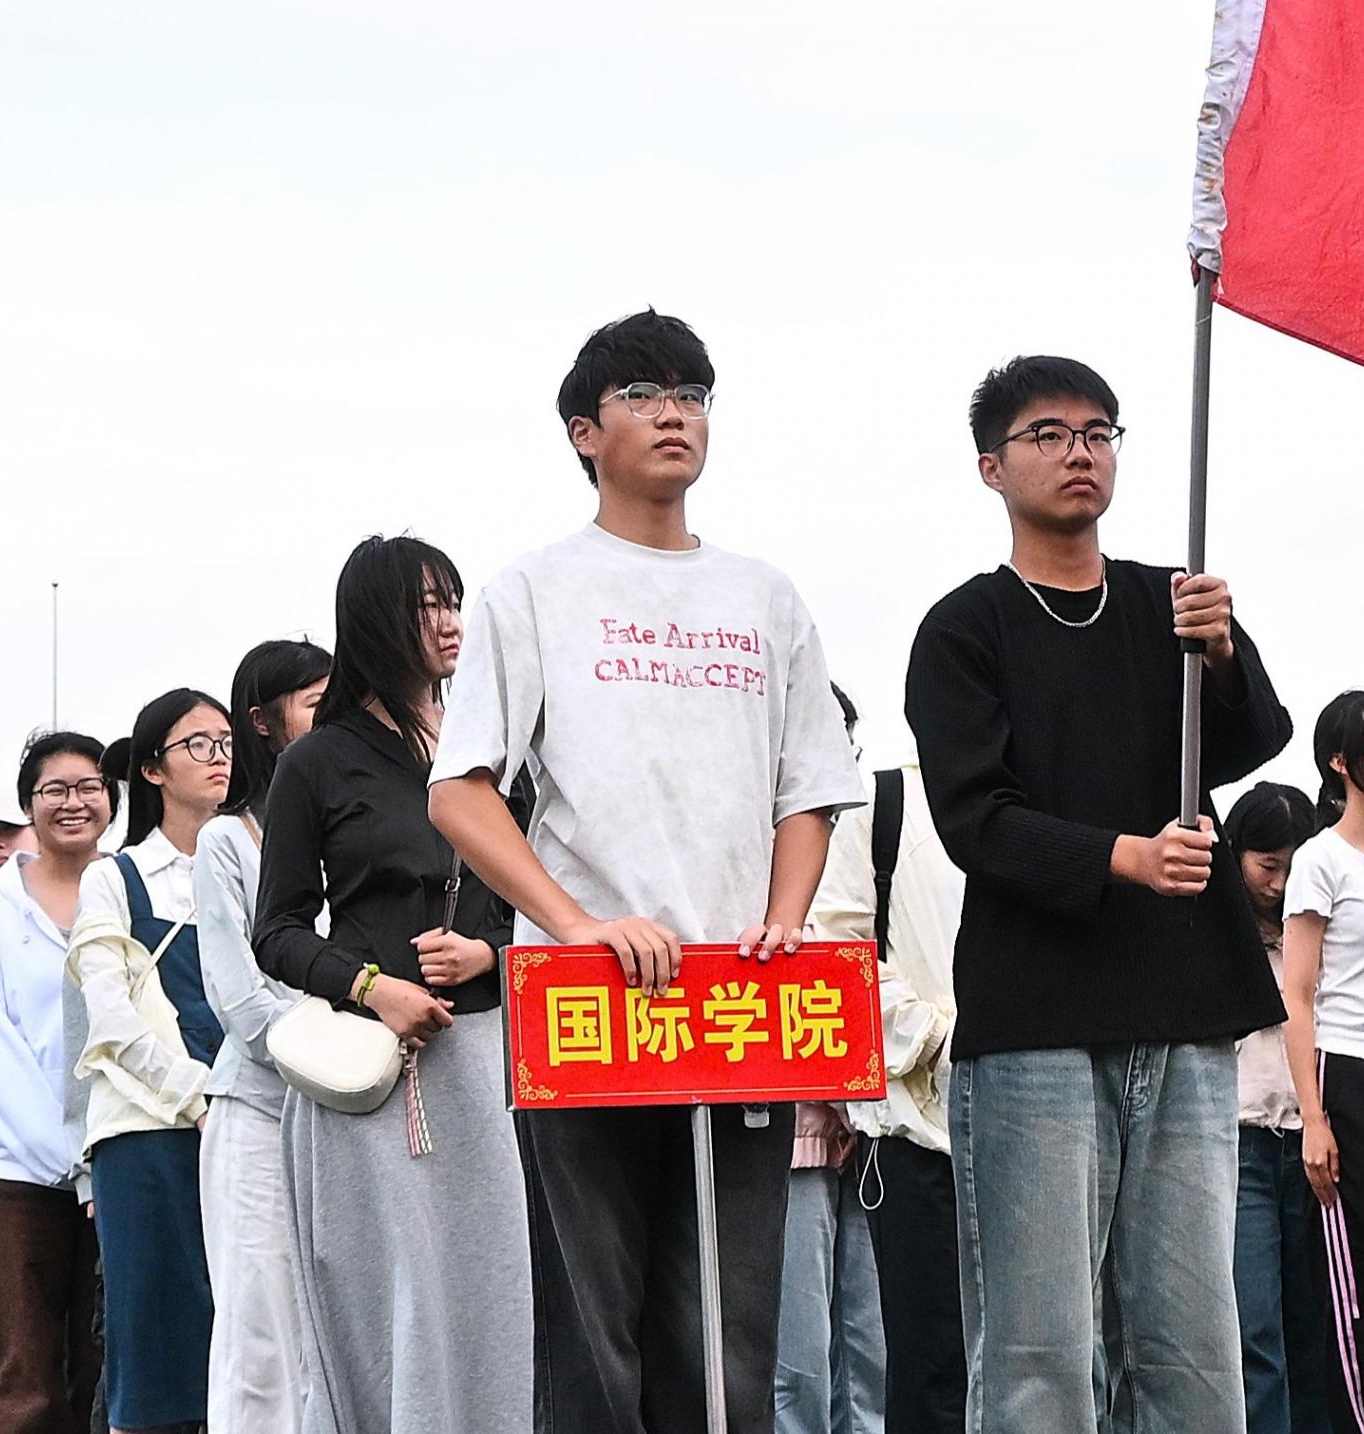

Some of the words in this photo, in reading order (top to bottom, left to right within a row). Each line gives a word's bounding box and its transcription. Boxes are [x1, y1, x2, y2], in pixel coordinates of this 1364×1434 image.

[663, 622, 760, 655] Arrival
[545, 980, 848, 1066] 国际学院
